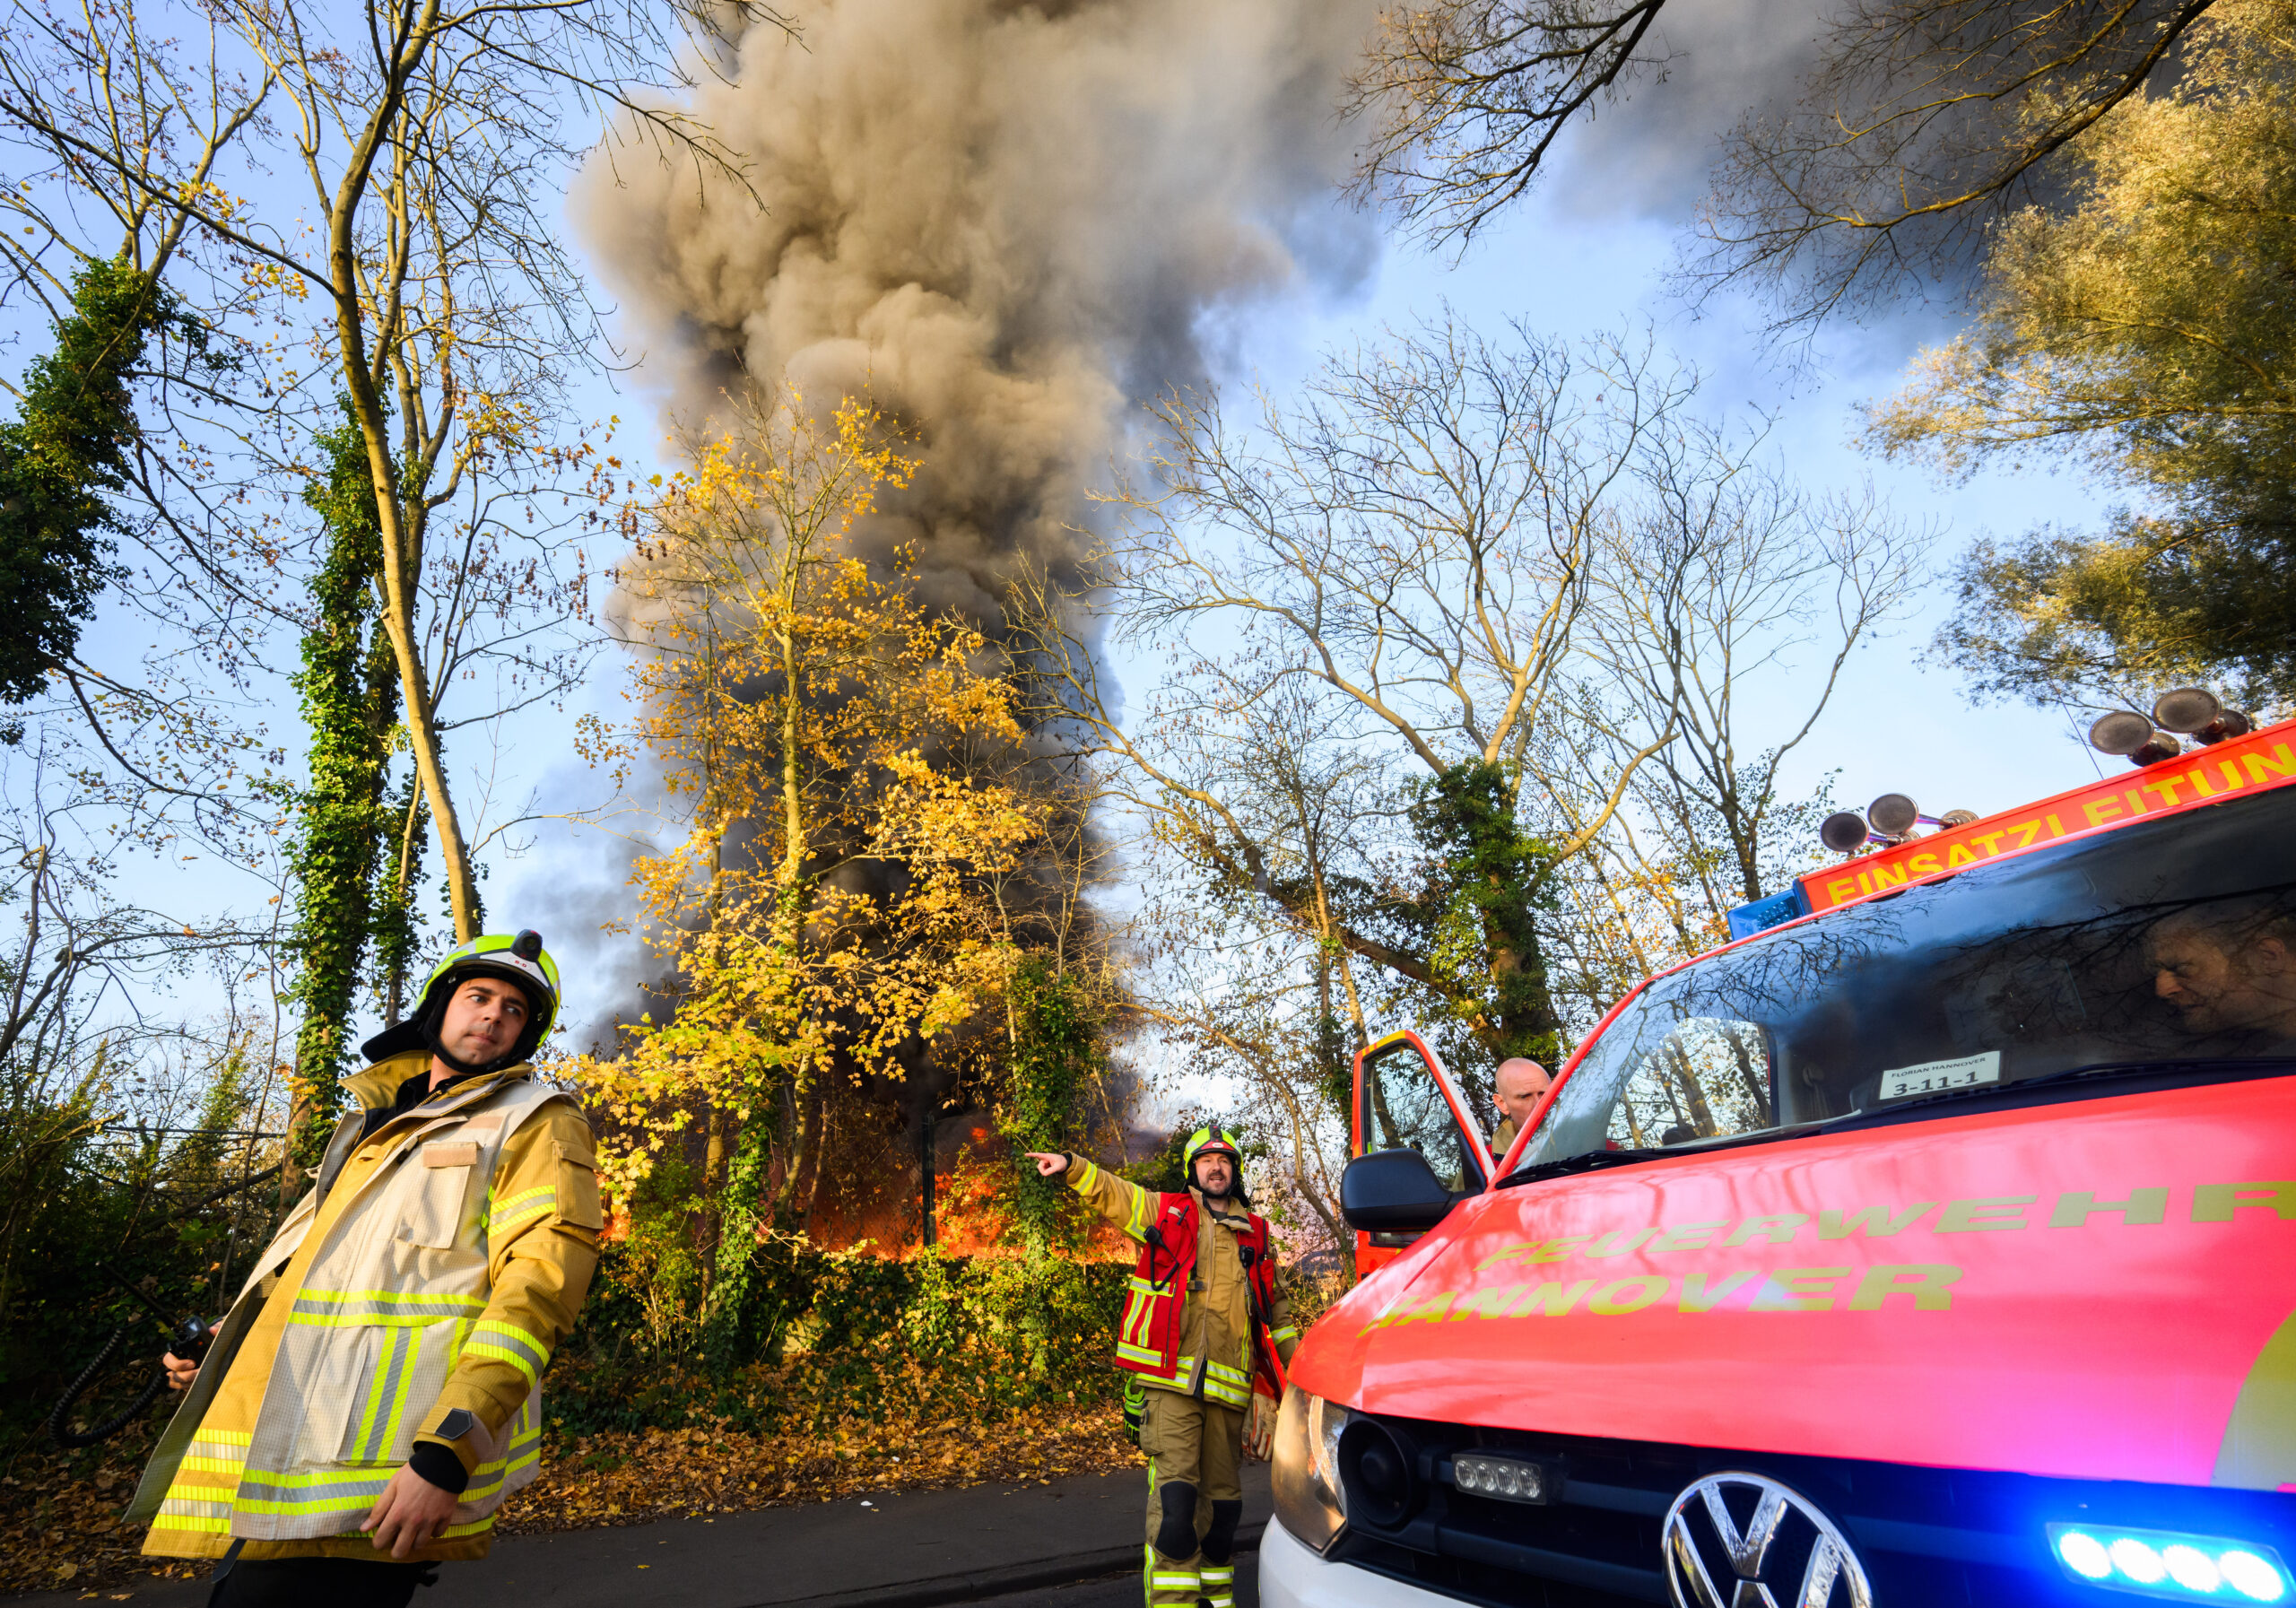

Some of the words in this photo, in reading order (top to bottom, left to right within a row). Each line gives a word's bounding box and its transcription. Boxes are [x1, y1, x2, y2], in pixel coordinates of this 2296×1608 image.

[1892, 1067, 1930, 1078] FLORIAN
[1932, 1057, 1987, 1070] HANNOVER
[1893, 1072, 1979, 1096] 3-11-1
[1473, 1181, 2296, 1271] FEUERWEHR
[1356, 1265, 1963, 1338] HANNOVER
